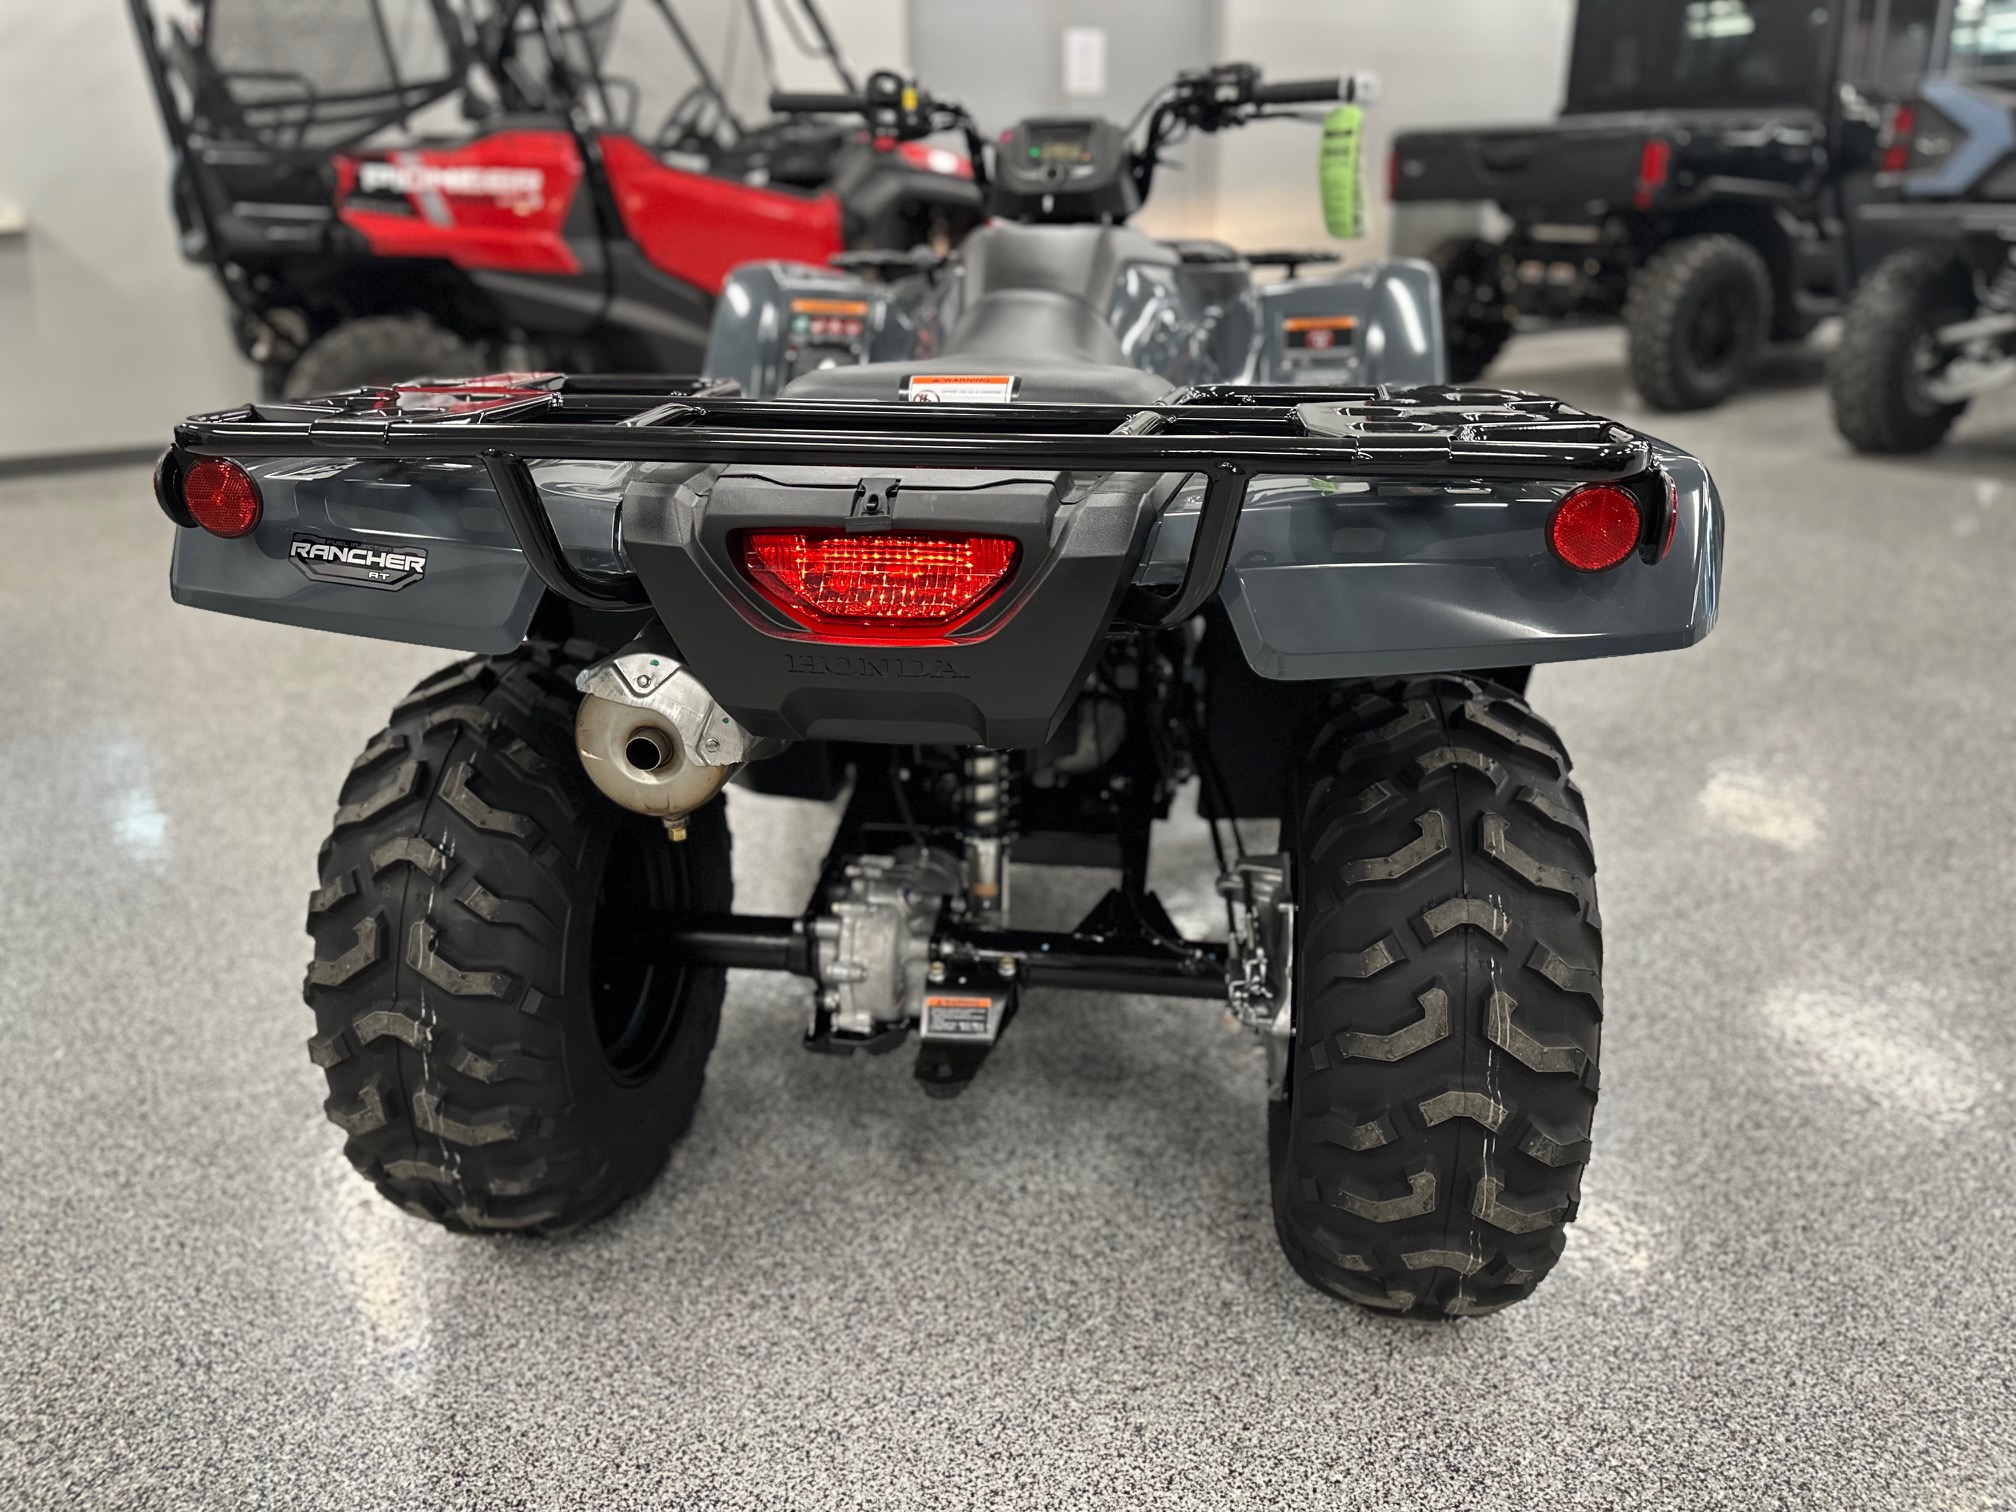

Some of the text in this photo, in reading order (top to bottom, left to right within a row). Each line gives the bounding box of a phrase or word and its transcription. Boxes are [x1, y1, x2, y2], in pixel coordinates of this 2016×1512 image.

[290, 541, 426, 573] RANCHER
[368, 571, 390, 580] AT
[786, 654, 970, 679] HONDA
